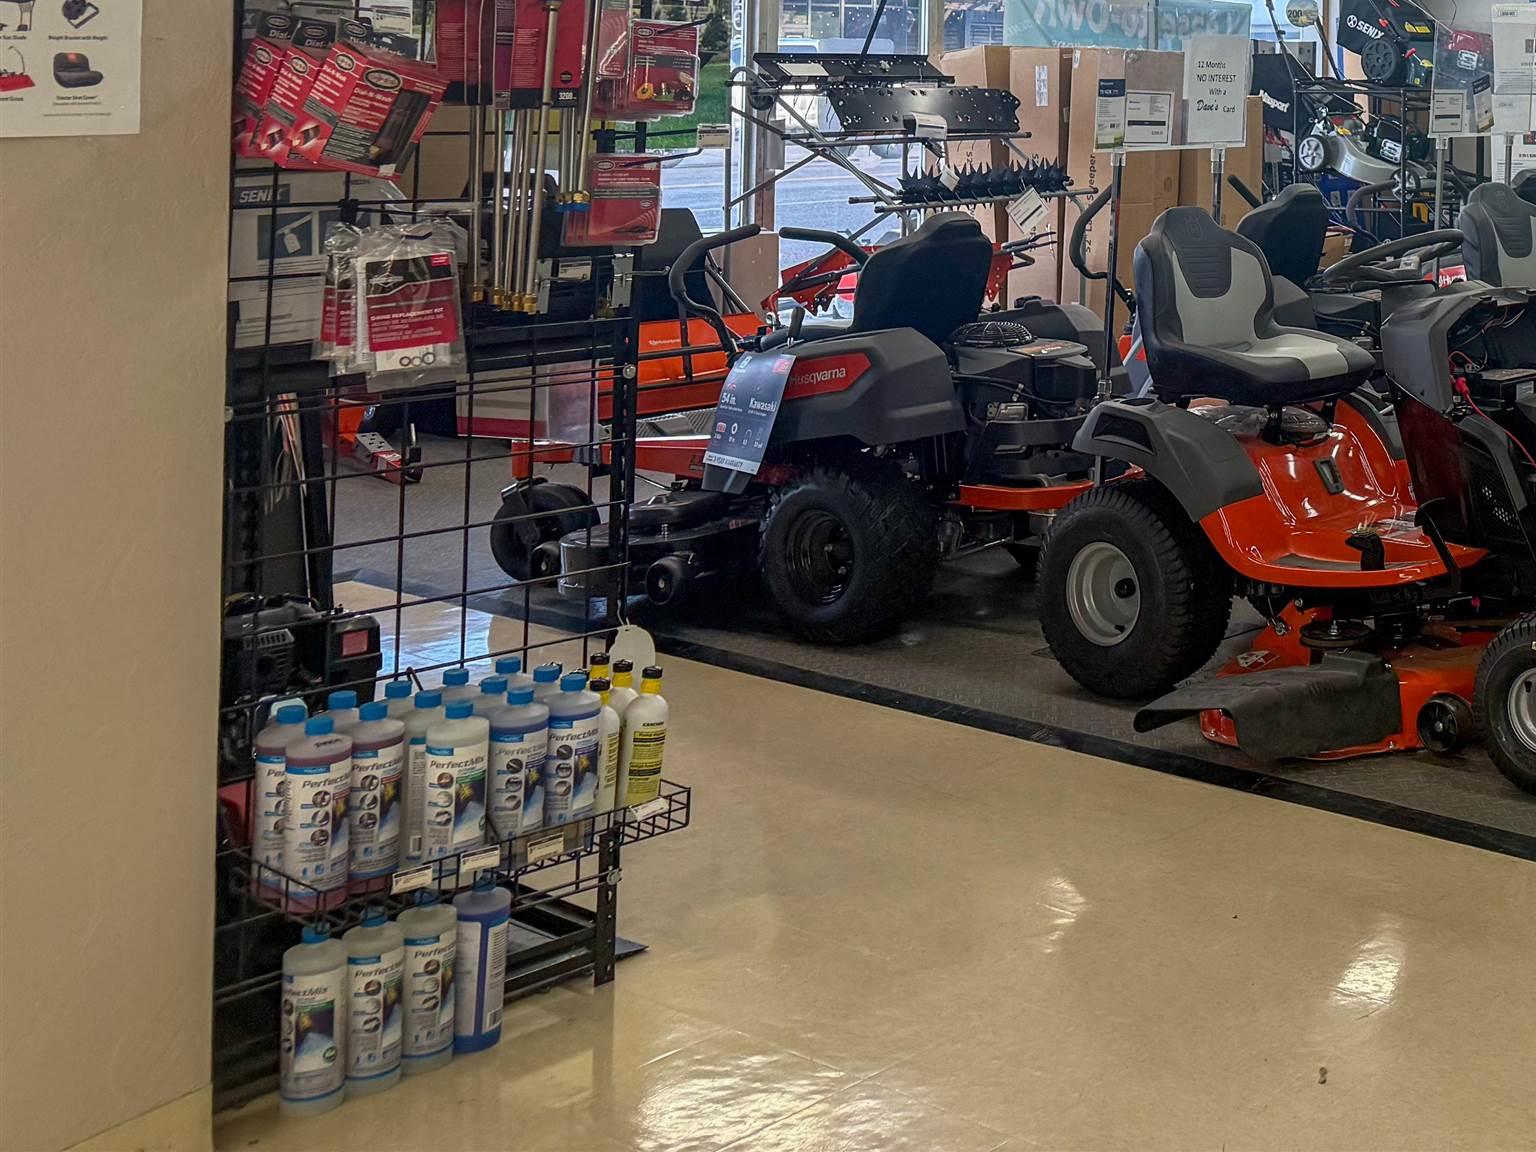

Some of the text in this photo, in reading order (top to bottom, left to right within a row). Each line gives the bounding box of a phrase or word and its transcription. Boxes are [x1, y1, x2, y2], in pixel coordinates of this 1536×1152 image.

[1356, 20, 1384, 39] SENIX
[1197, 60, 1226, 69] 12 Months
[1196, 74, 1237, 83] NO INTEREST
[1209, 87, 1222, 96] With
[1196, 99, 1236, 113] Dave's Card
[1087, 154, 1096, 201] Seeper
[748, 397, 778, 412] Kawasaki
